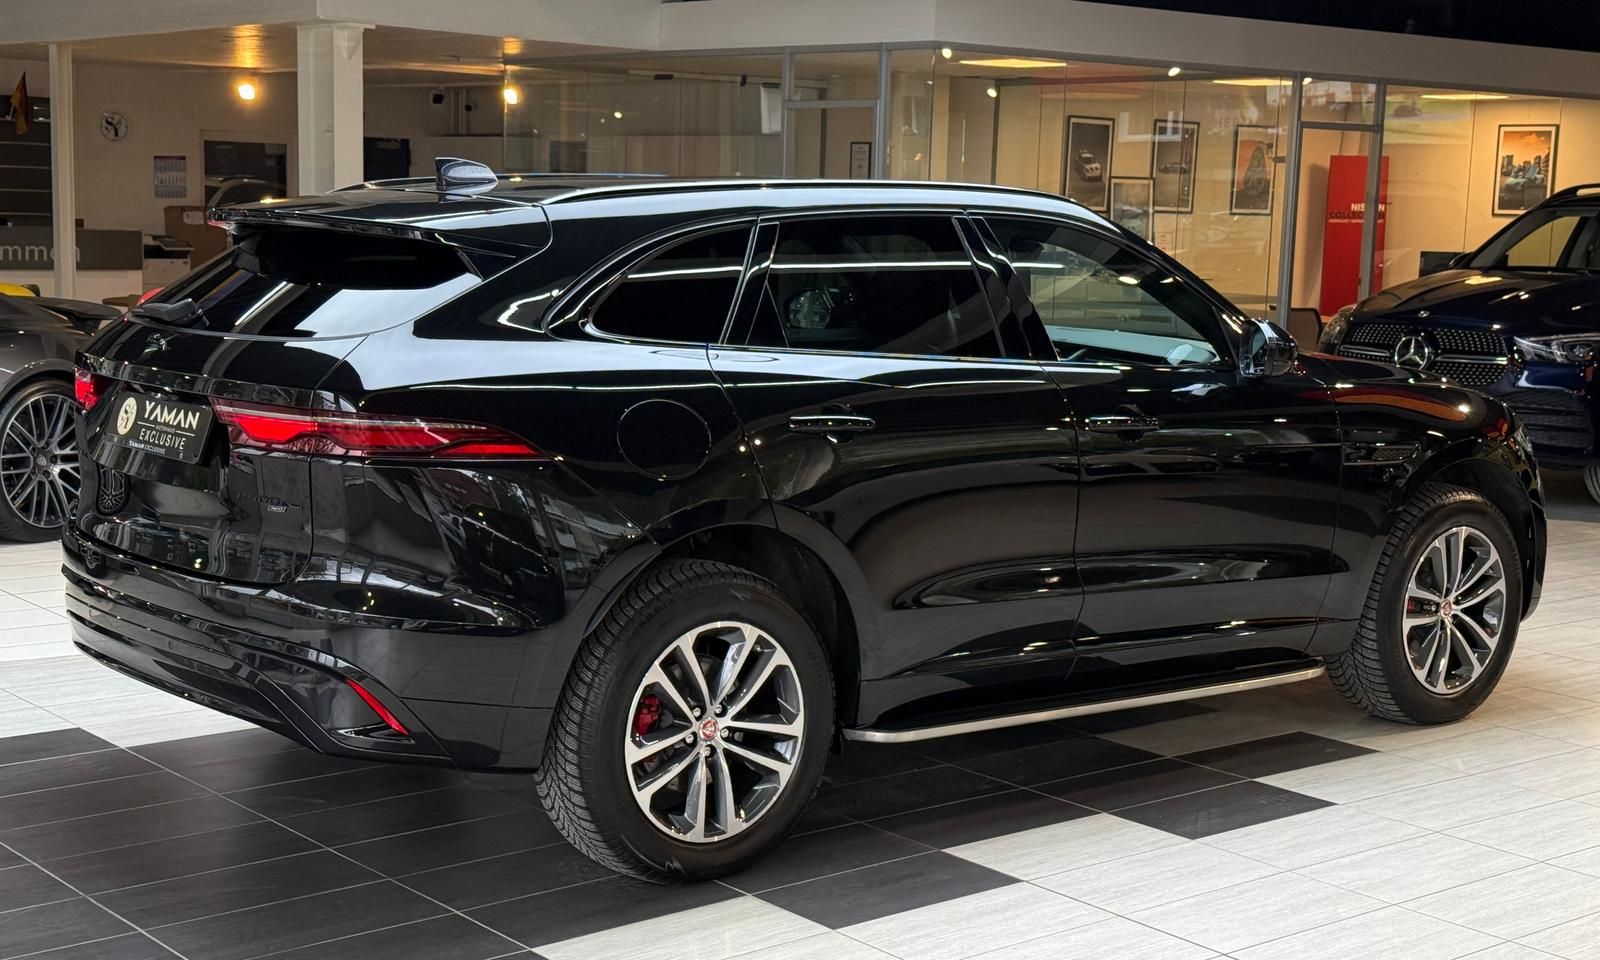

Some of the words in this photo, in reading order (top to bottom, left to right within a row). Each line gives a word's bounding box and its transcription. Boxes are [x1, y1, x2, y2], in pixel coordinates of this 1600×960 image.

[1351, 203, 1385, 211] NISN
[1329, 211, 1385, 219] COLLECN
[144, 400, 200, 430] YAMAN
[139, 428, 187, 450] EXCLUSIVE
[129, 440, 145, 449] YAMAN
[145, 443, 166, 455] EXCLUSIVE
